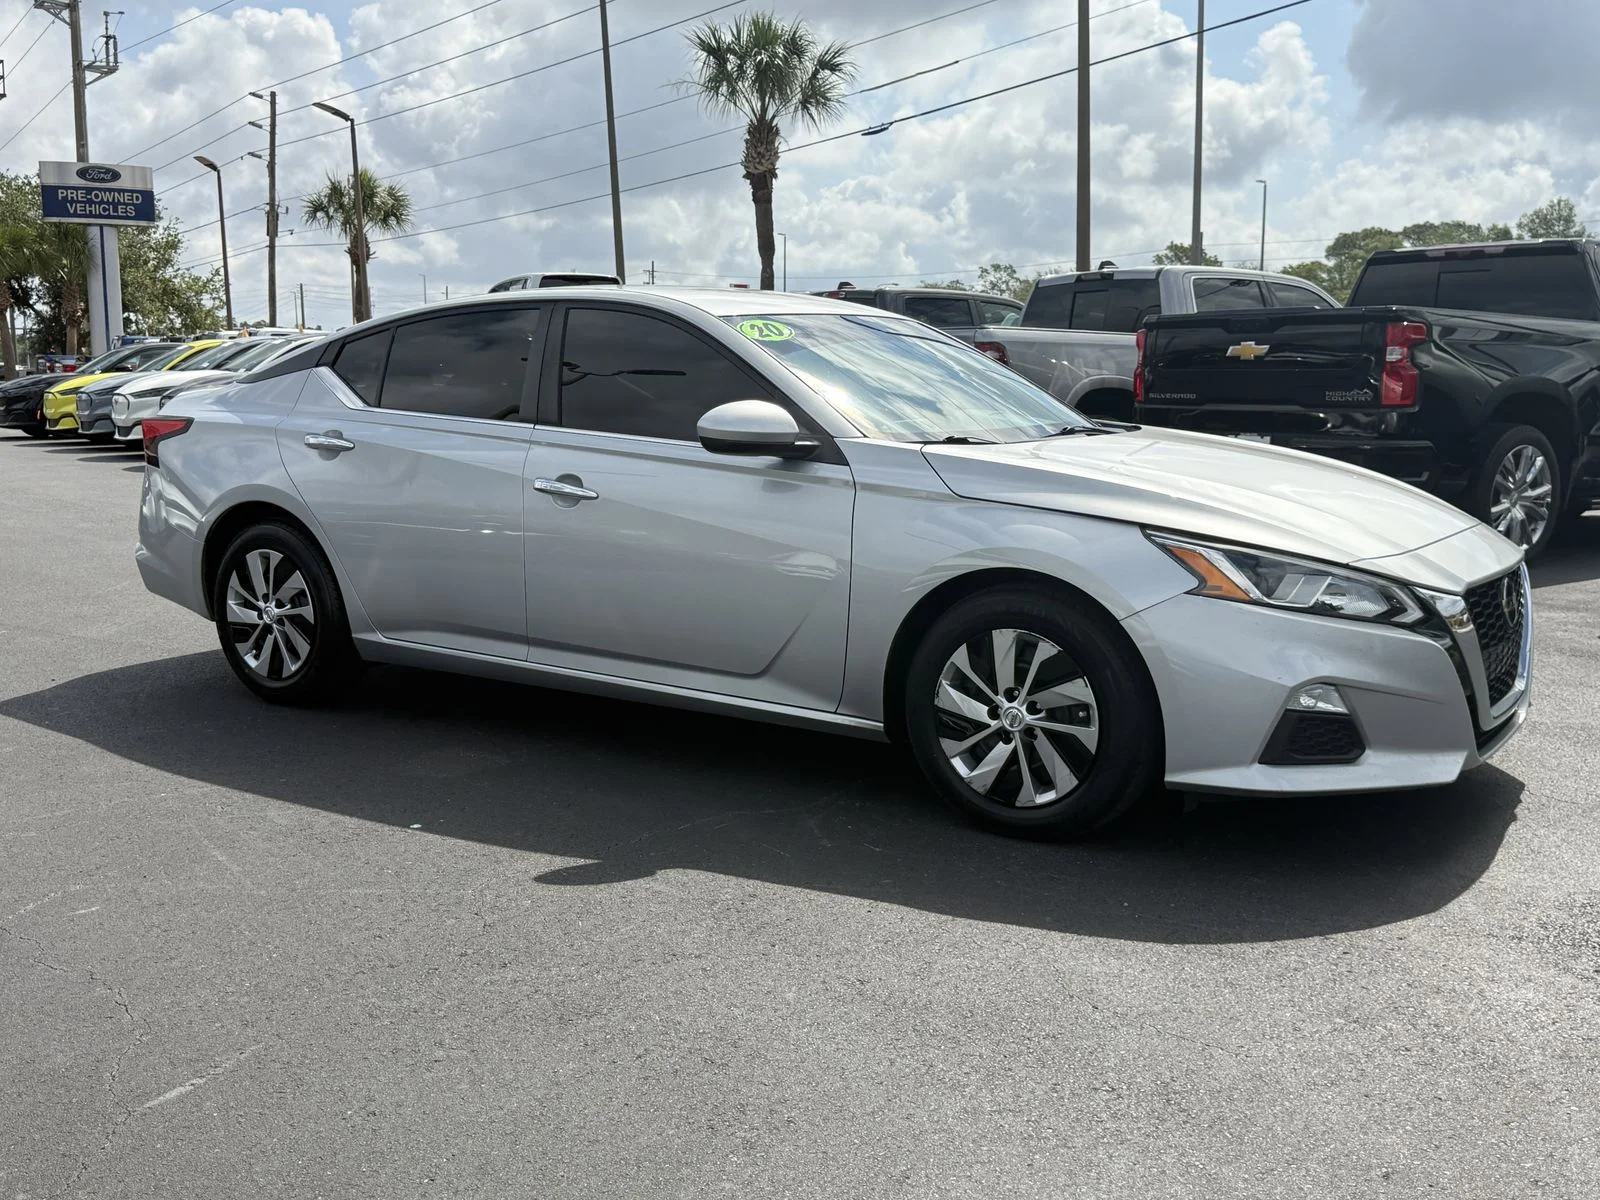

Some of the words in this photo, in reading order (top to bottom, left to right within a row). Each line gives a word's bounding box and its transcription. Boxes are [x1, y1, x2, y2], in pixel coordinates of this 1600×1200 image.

[86, 168, 113, 180] Ford
[58, 189, 142, 204] PRE-OWNED
[67, 203, 136, 217] VEHICLES
[749, 322, 785, 338] 20
